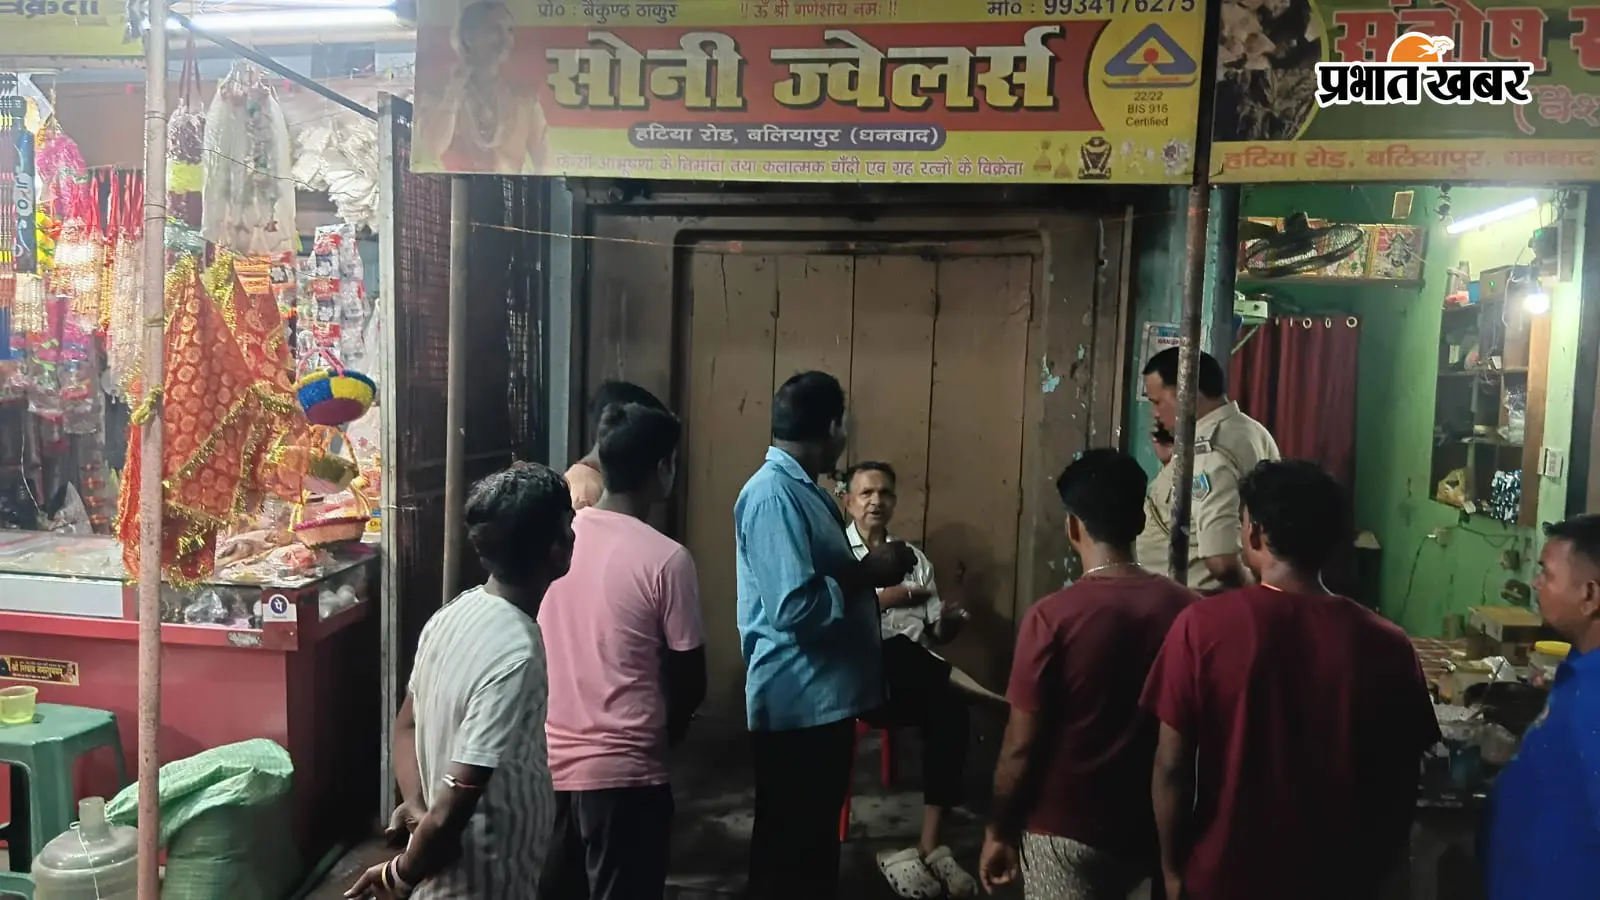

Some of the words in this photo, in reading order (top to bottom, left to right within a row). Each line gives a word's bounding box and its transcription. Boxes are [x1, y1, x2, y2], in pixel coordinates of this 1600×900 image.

[635, 3, 679, 24] ठाकुर
[545, 31, 749, 113] सोनी
[770, 25, 1067, 113] ज्वेलर्स
[1127, 104, 1146, 114] BIS
[1149, 104, 1169, 114] 916
[1125, 116, 1169, 127] Certified
[634, 123, 693, 142] हटिया
[699, 123, 739, 144] रोड,
[747, 124, 842, 147] बलियापुर
[850, 126, 939, 145] (धनबाद)
[762, 160, 826, 174] कलात्मक
[892, 160, 914, 176] ग्रह
[957, 155, 972, 175] के
[977, 155, 1025, 176] विक्रेता
[1224, 145, 1296, 170] हटिया
